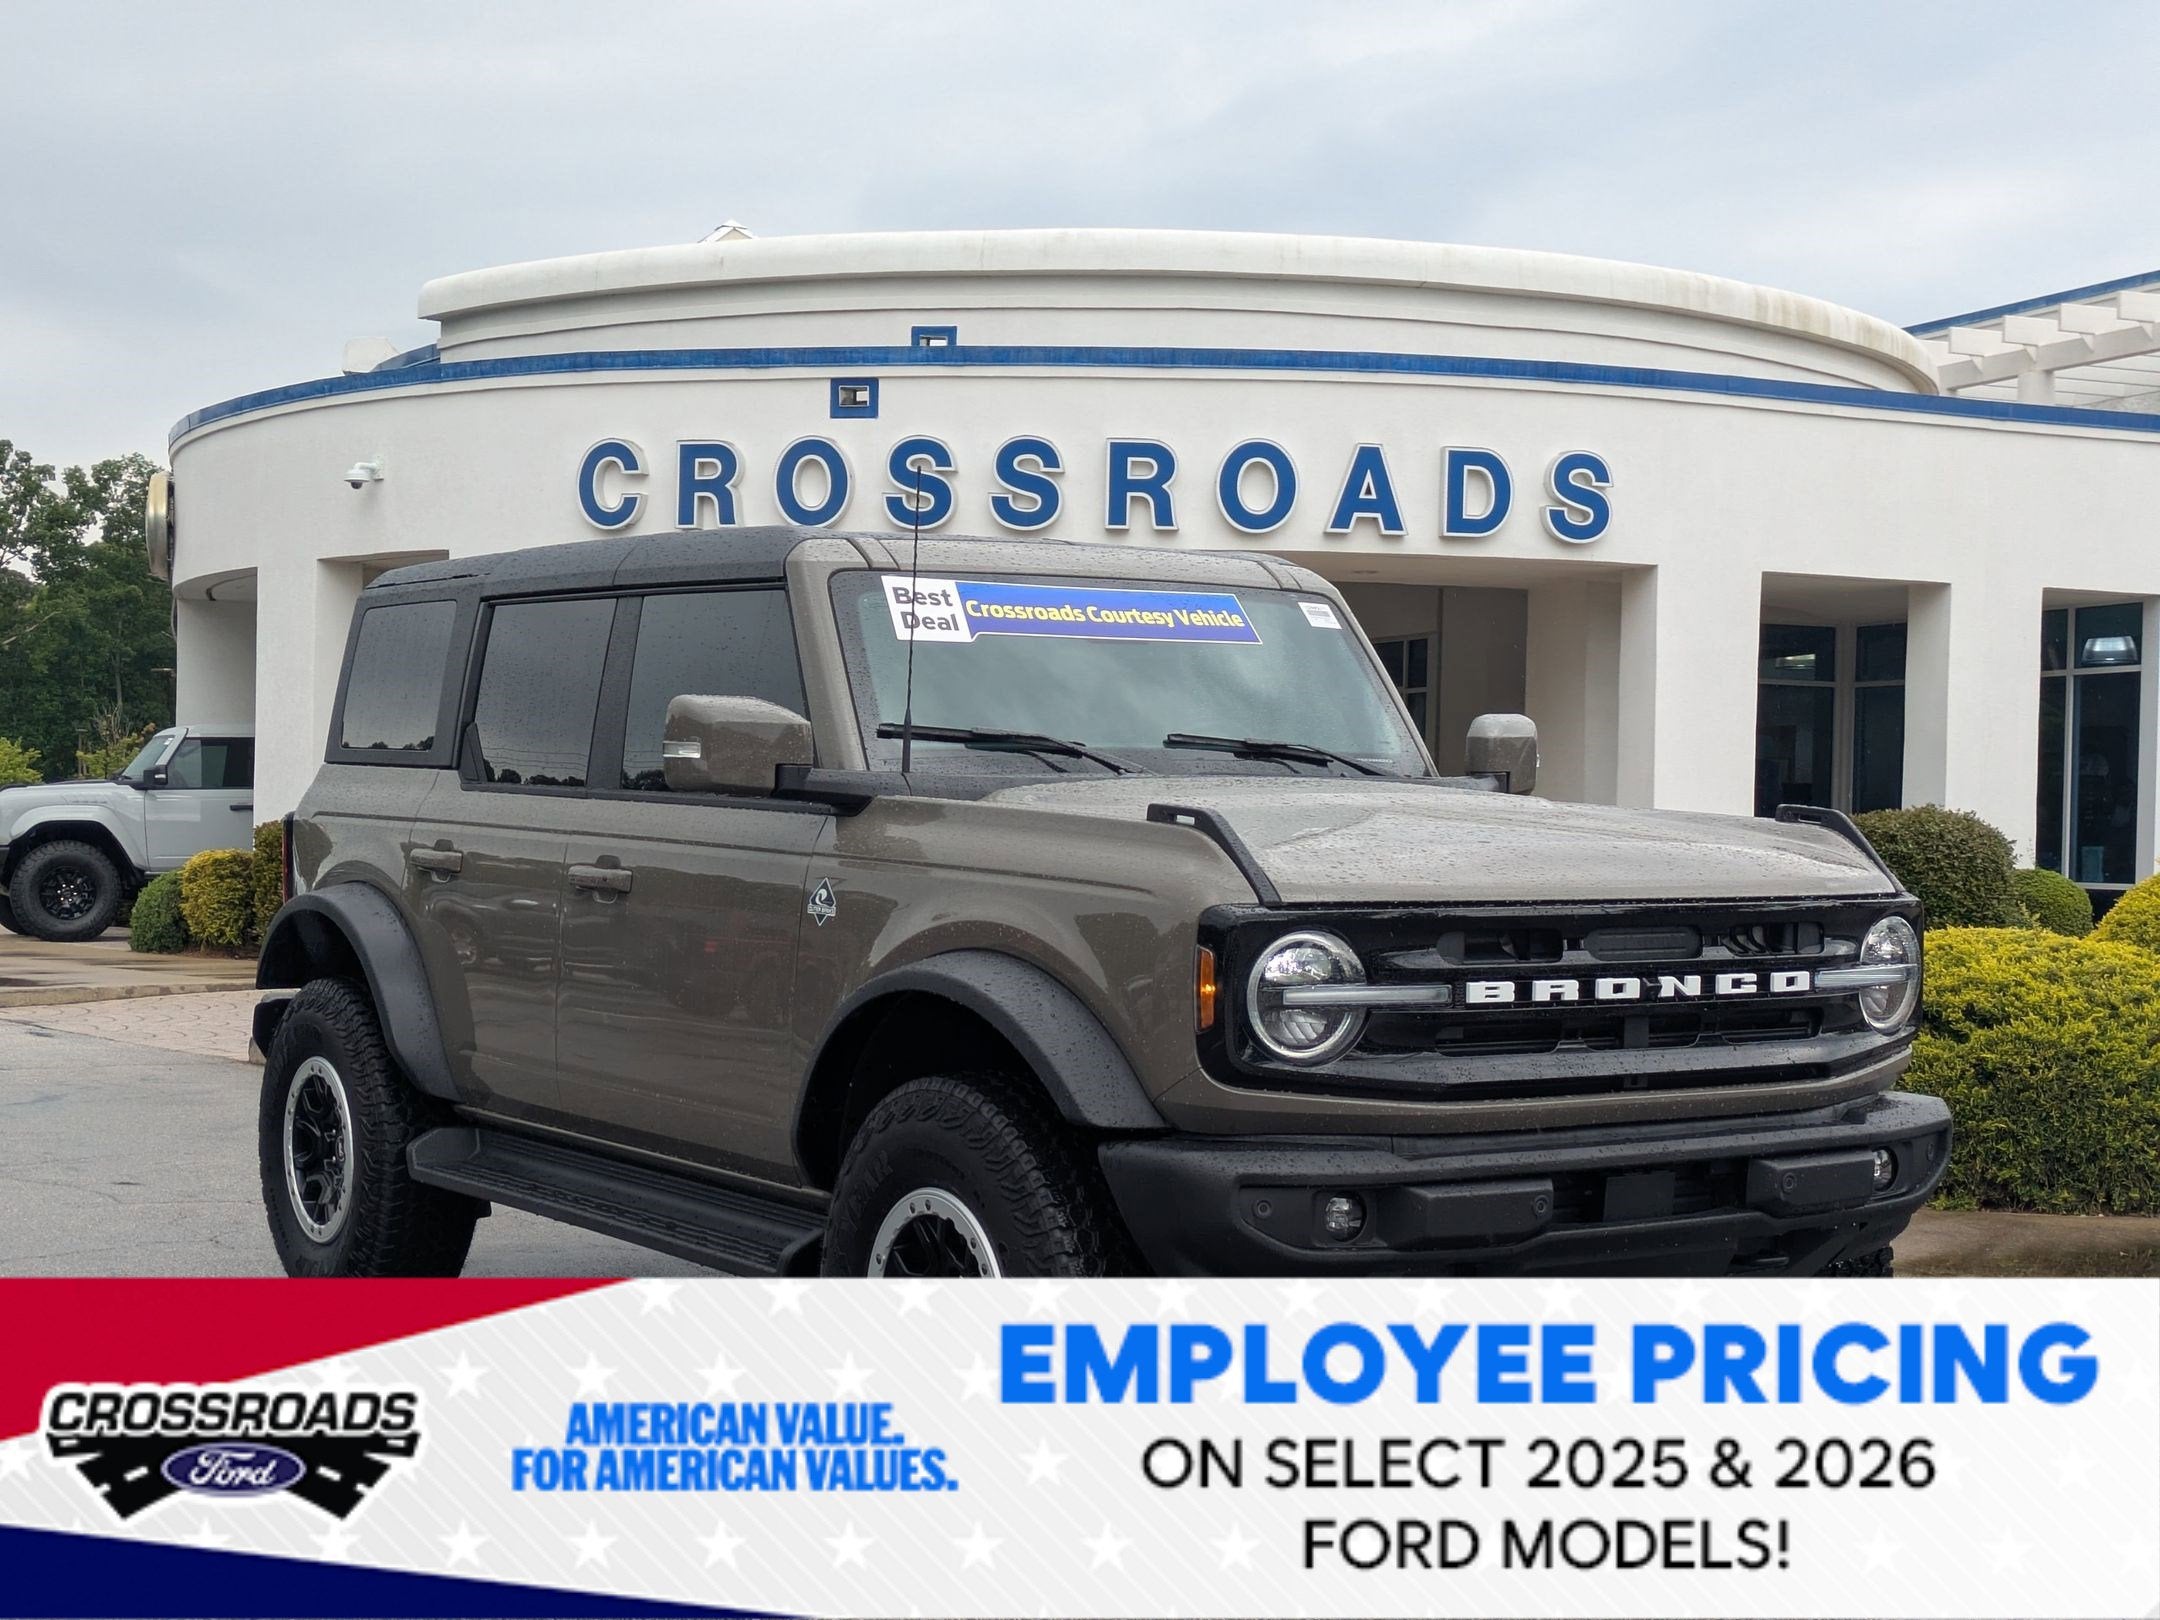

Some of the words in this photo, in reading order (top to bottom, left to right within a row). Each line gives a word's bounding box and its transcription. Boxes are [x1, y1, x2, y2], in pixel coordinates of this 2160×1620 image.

[577, 435, 1613, 544] CROSSROADS
[892, 586, 954, 607] Best
[900, 611, 960, 632] Deal
[965, 599, 1086, 622] Crossroads
[1086, 606, 1175, 628] Courtesy
[1173, 609, 1246, 628] Vehicle
[1465, 970, 1811, 1005] BRONCO
